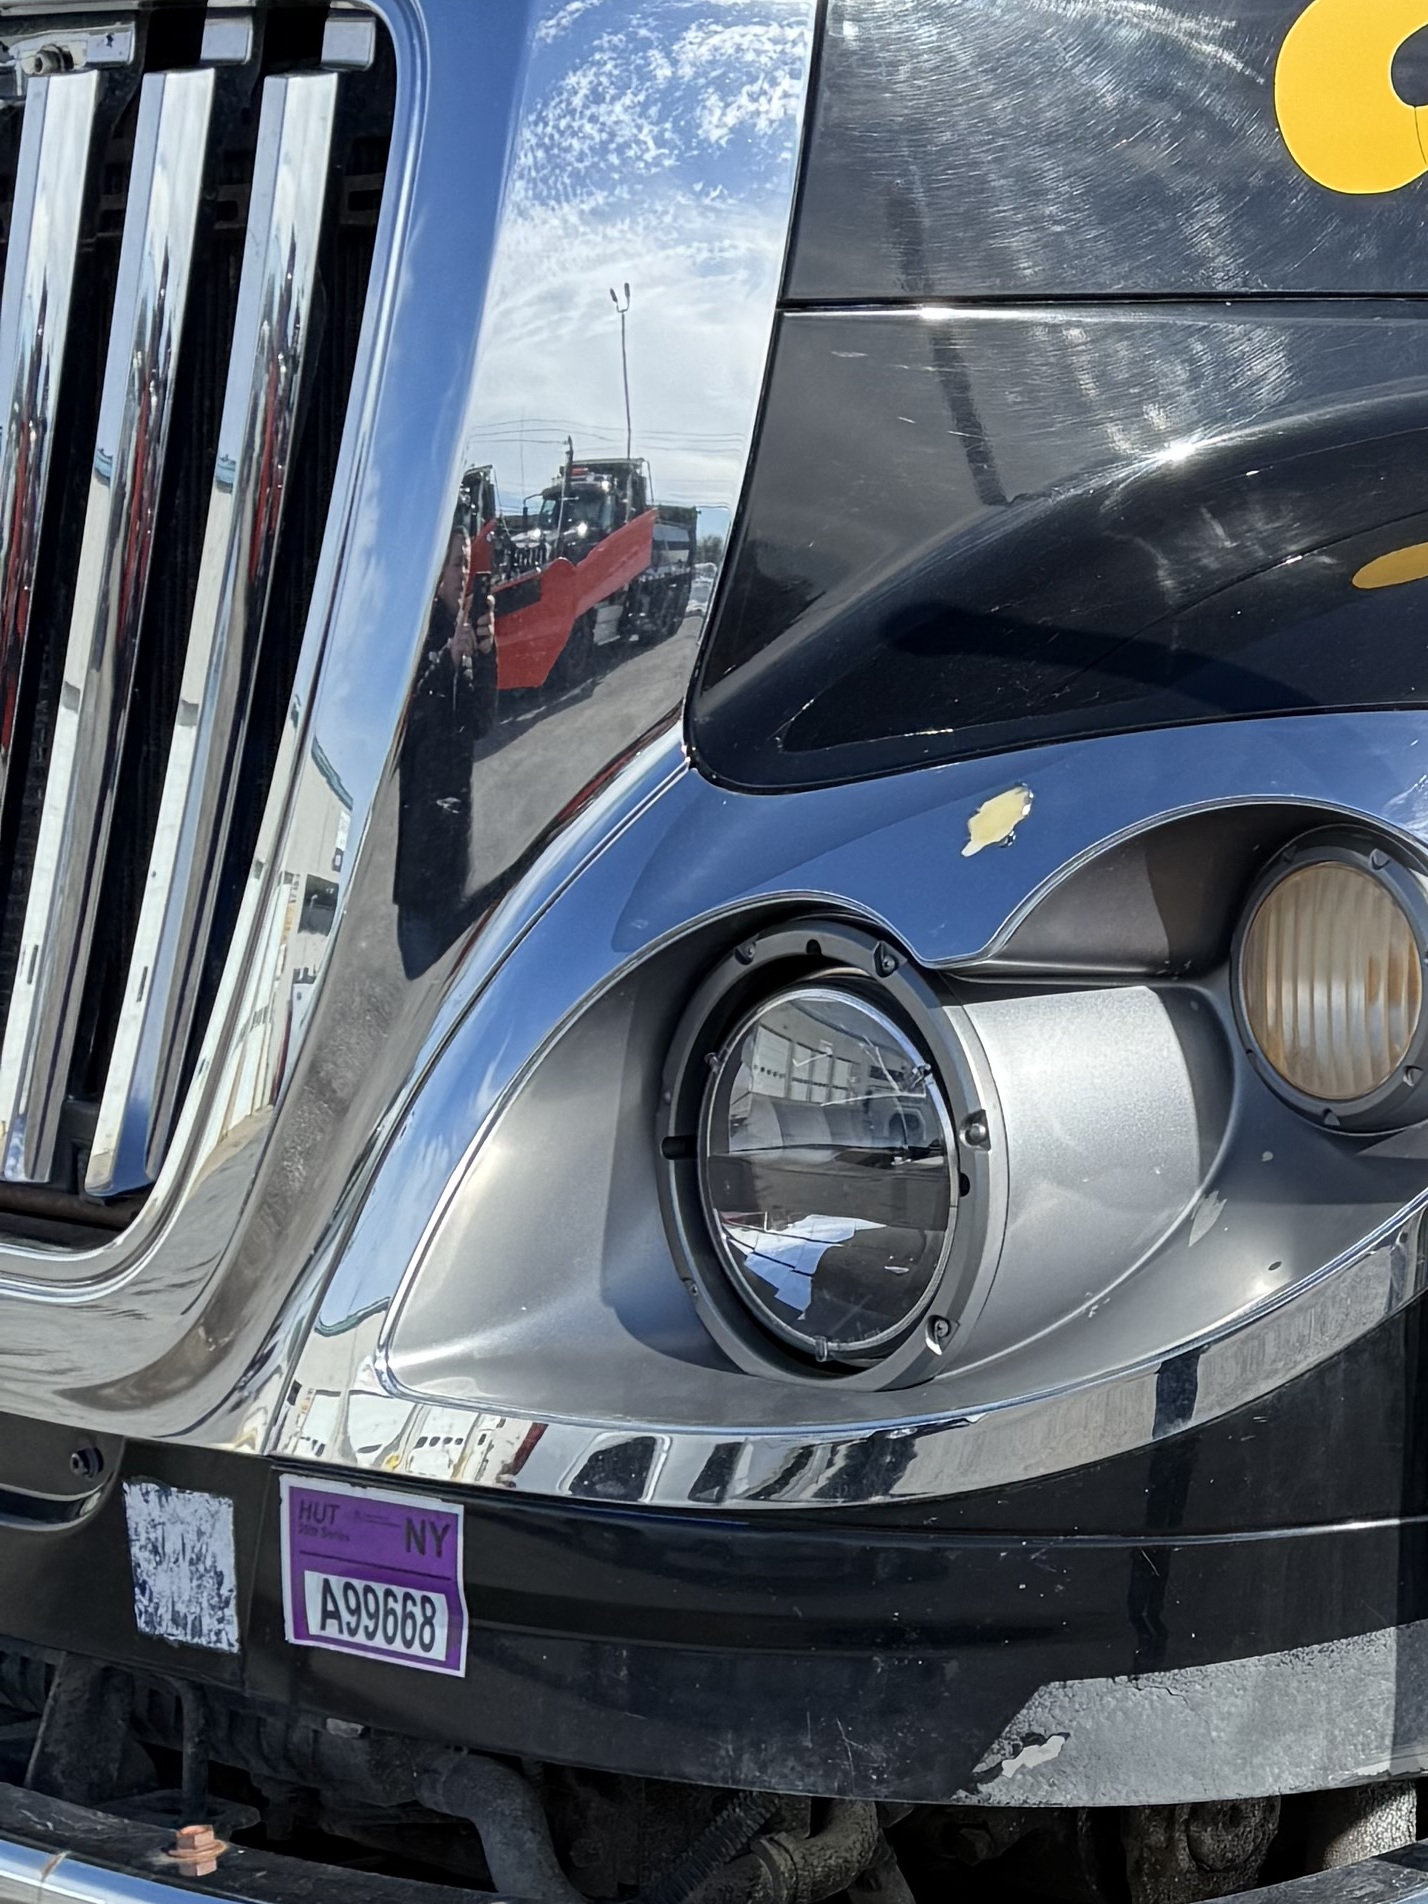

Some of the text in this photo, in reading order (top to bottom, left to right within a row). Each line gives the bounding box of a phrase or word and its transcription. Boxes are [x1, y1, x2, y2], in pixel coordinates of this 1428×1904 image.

[298, 1499, 341, 1526] HUT
[405, 1516, 451, 1559] NY
[320, 1576, 437, 1654] A99668
